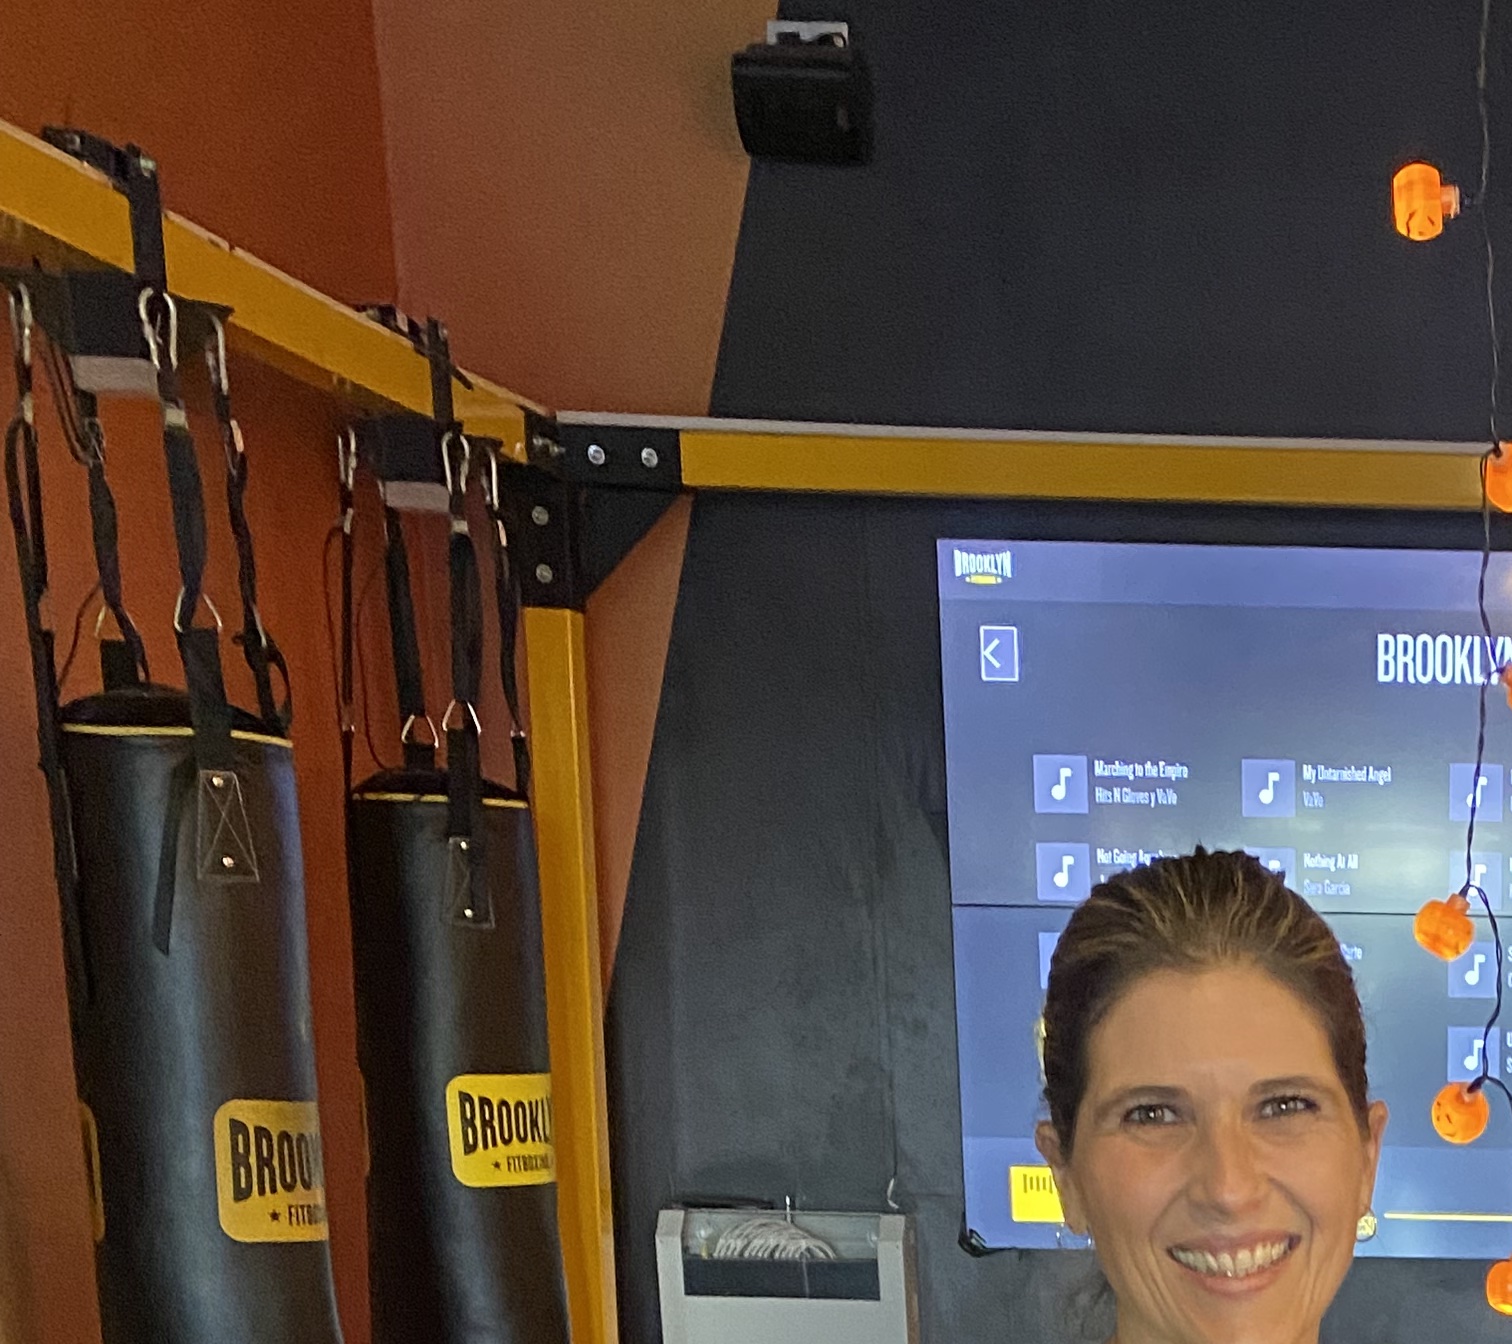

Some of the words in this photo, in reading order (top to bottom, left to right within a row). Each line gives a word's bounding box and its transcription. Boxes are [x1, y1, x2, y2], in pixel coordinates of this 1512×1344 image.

[953, 549, 1012, 578] BROOKLYN
[1094, 760, 1134, 780] Marching
[1135, 763, 1144, 778] to
[1145, 761, 1158, 778] the
[1159, 761, 1189, 781] Empire
[1303, 764, 1316, 784] My
[1318, 765, 1367, 782] Untarnished
[1368, 766, 1392, 785] Angel
[1097, 848, 1112, 864] Not
[1303, 853, 1336, 872] Nothing
[1337, 854, 1346, 869] At
[1347, 854, 1358, 869] All
